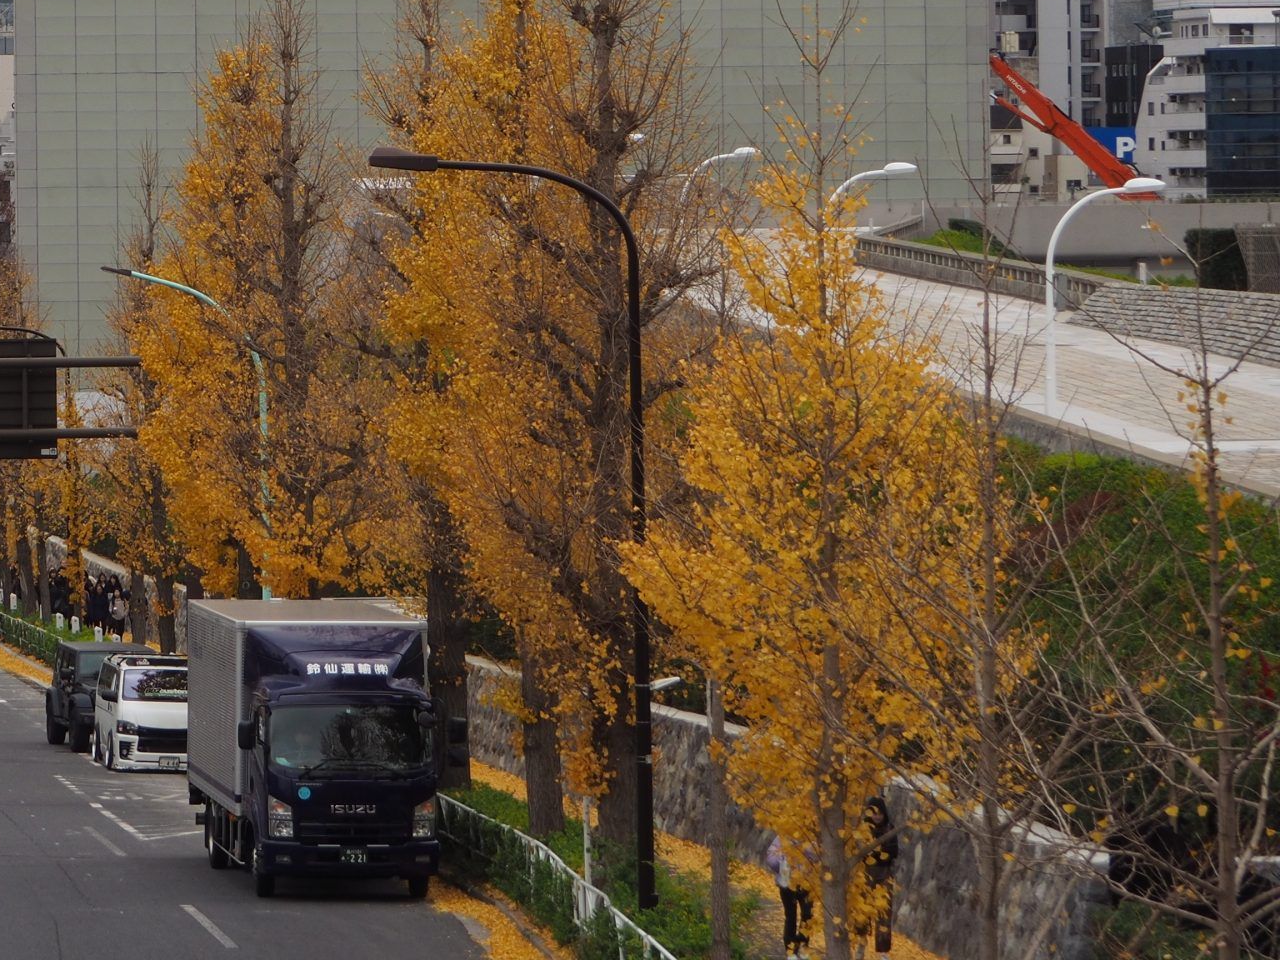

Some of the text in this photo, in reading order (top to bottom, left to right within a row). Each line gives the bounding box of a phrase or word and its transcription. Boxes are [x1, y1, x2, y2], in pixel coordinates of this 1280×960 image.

[1006, 75, 1027, 95] HITACHI
[1116, 137, 1136, 158] P
[330, 804, 376, 814] ISUZU
